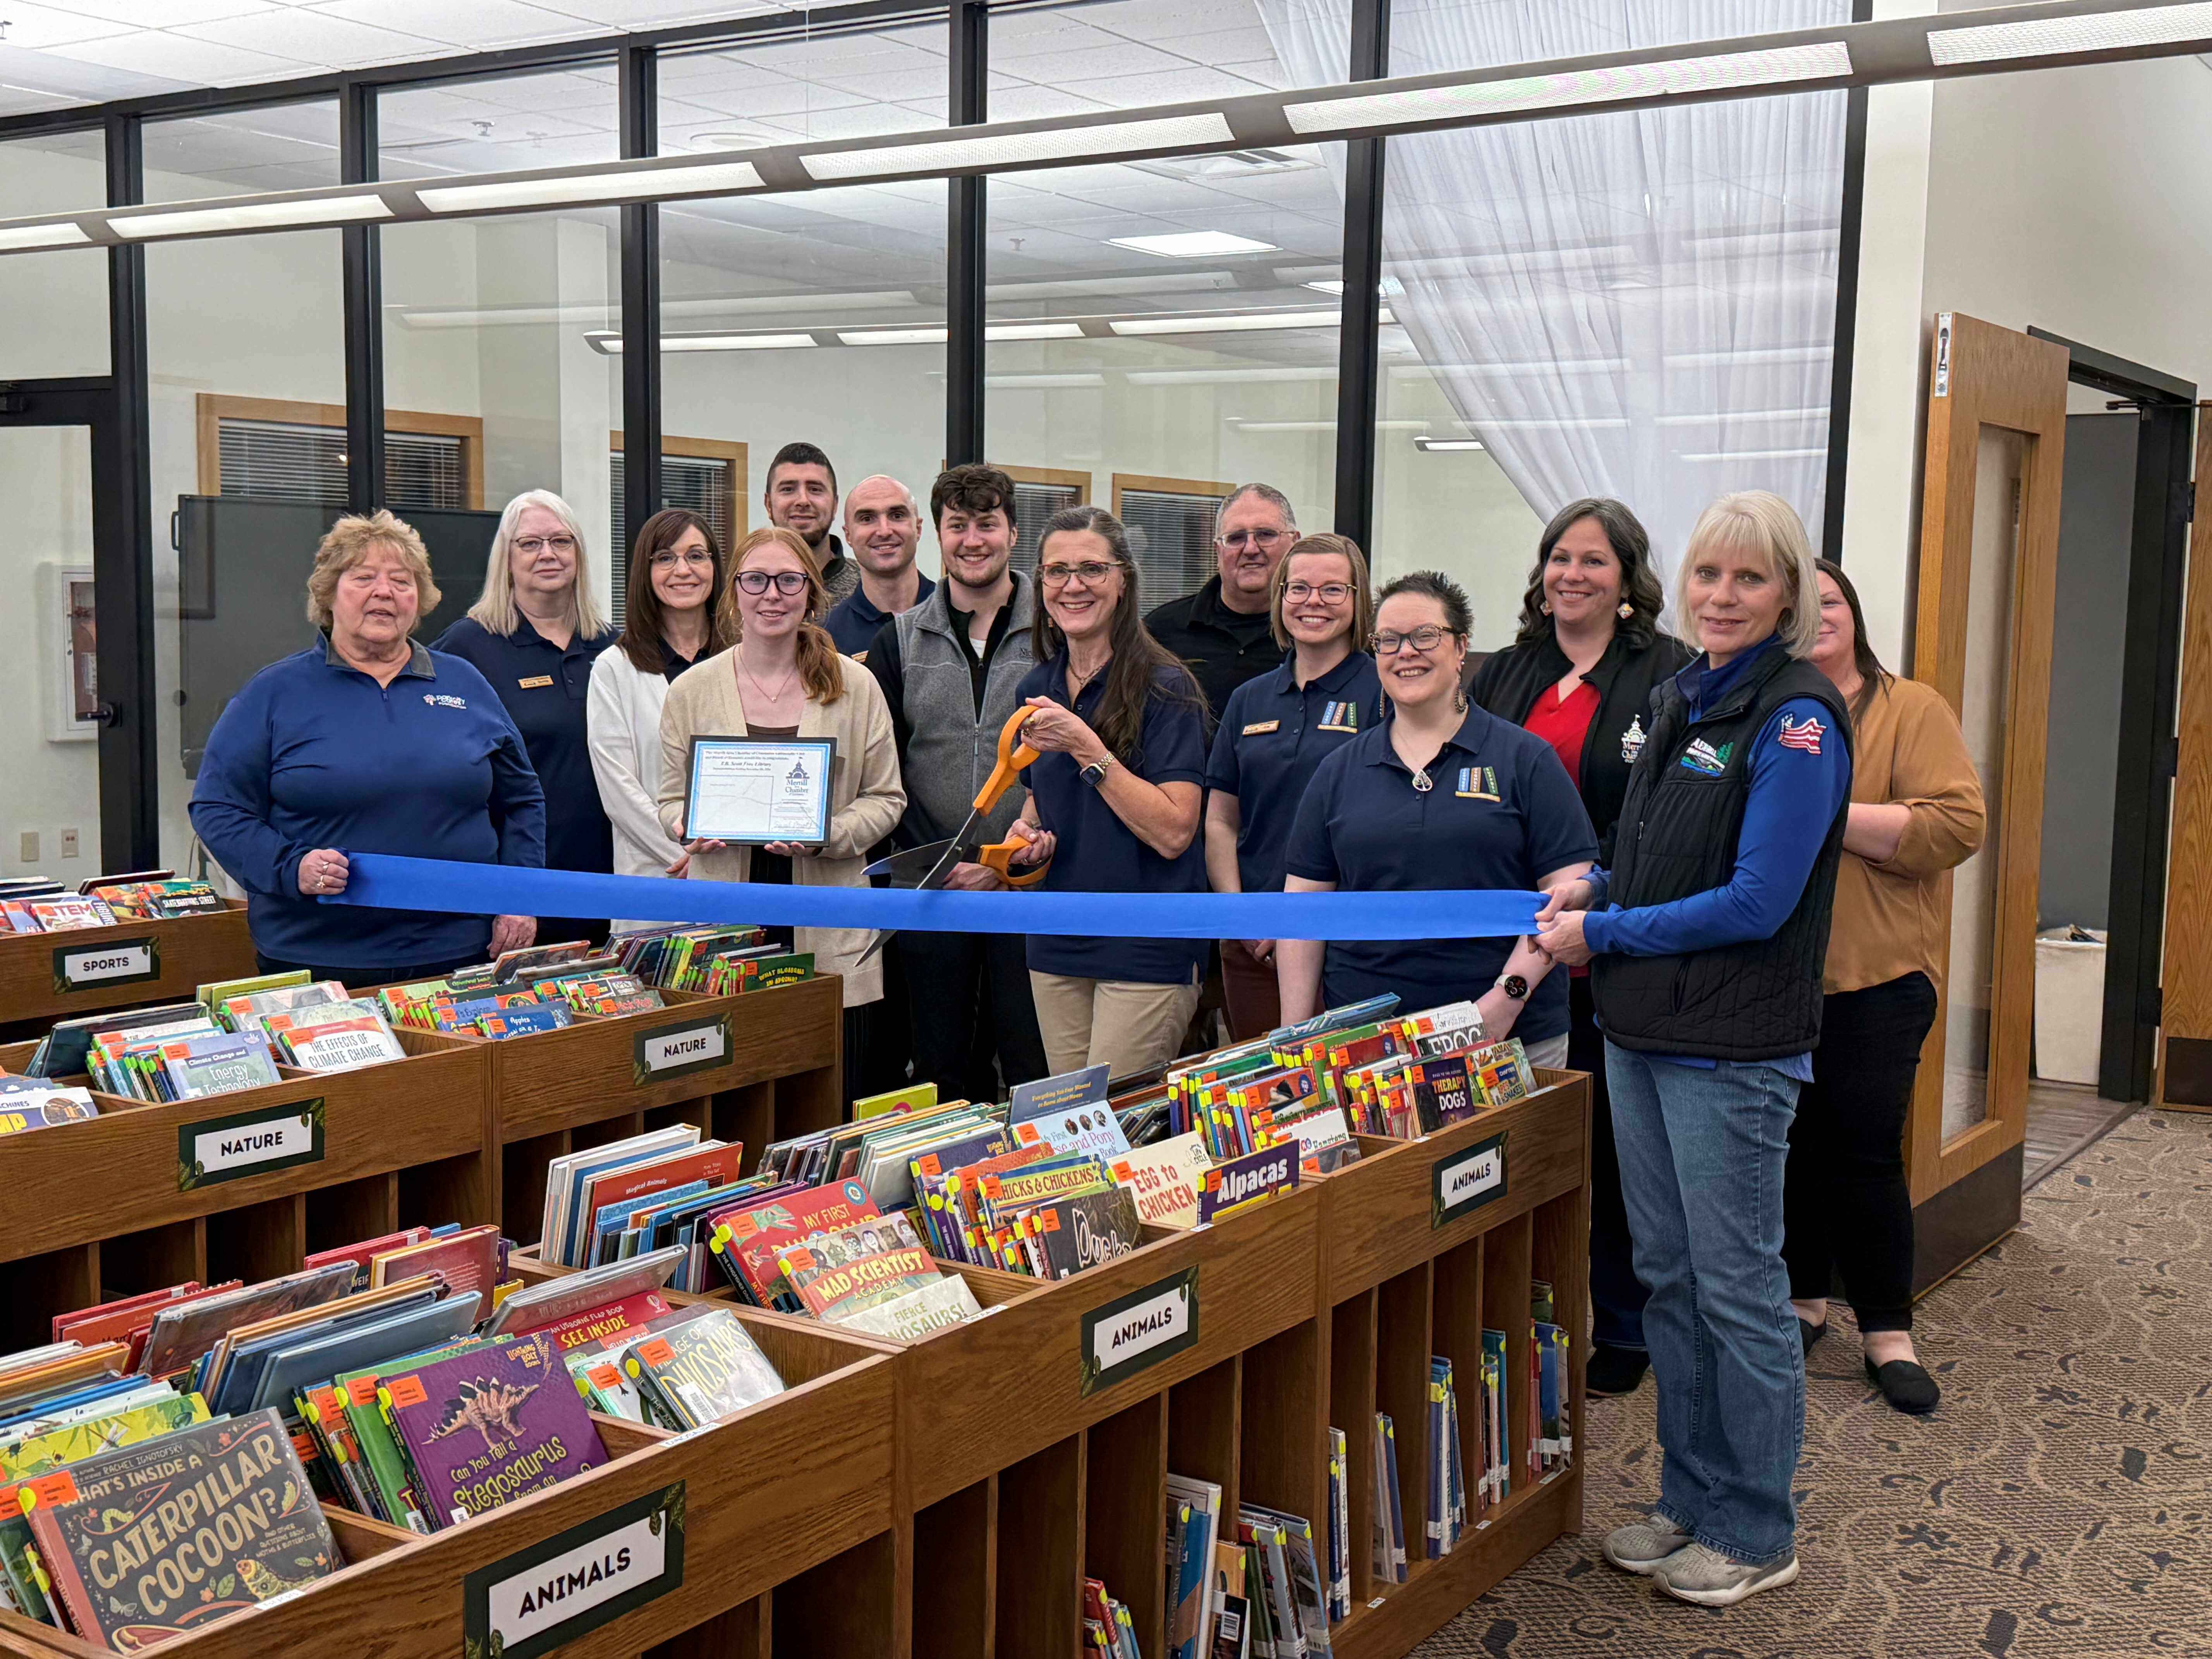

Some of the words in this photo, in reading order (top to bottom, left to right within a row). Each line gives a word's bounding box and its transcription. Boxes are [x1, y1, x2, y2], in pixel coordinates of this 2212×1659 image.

[83, 957, 129, 972] SPORTS
[759, 970, 776, 981] WHAT
[510, 1016, 531, 1025] Apples
[309, 1041, 326, 1053] THE
[327, 1036, 356, 1050] EFFECTS
[357, 1033, 368, 1045] OF
[664, 1037, 706, 1058] NATURE
[188, 1057, 211, 1066] Climate
[213, 1053, 234, 1063] Change
[235, 1049, 246, 1058] and
[308, 1051, 349, 1068] CLIMATE
[349, 1044, 385, 1061] CHANGE
[210, 1063, 248, 1085] Energy
[1432, 1076, 1466, 1094] THERAPY
[1438, 1091, 1467, 1111] DOGS
[221, 1132, 283, 1156] NATURE
[1052, 1130, 1068, 1142] First
[1069, 1134, 1091, 1150] and
[1091, 1130, 1116, 1145] Pony
[1098, 1144, 1119, 1158] Book
[625, 1182, 646, 1195] Magical
[646, 1178, 668, 1189] Animals
[1035, 1179, 1042, 1193] &
[1044, 1167, 1094, 1191] CHICKENS
[1132, 1166, 1161, 1194] EGG
[1161, 1164, 1178, 1183] to
[1216, 1158, 1288, 1204] Alpacas
[1452, 1162, 1491, 1194] ANIMALS
[1138, 1183, 1196, 1220] CHICKEN
[802, 1212, 821, 1230] MY
[821, 1203, 851, 1224] FIRST
[1073, 1208, 1133, 1271] Ducks
[720, 1254, 730, 1264] THE
[725, 1263, 745, 1290] KINGFISHER
[815, 1273, 852, 1302] MAD
[850, 1251, 925, 1286] SCIENTIST
[750, 1281, 761, 1293] MY
[854, 1276, 905, 1300] ACADEMY
[560, 1316, 589, 1331] USBORNE
[589, 1312, 606, 1322] FLAP
[606, 1305, 625, 1317] BOOK
[893, 1301, 928, 1323] FIERCE
[561, 1328, 589, 1348] SEE
[587, 1314, 630, 1338] INSIDE
[1111, 1306, 1173, 1349] ANIMALS
[506, 1343, 536, 1361] LIGHTNING
[671, 1335, 692, 1357] AGE
[689, 1324, 705, 1341] OF
[521, 1351, 538, 1363] BOLT
[524, 1360, 541, 1369] BOOKS
[649, 1395, 663, 1412] THE
[103, 1459, 135, 1474] RACHEL
[135, 1443, 184, 1465] IGNOTOFSKY
[451, 1465, 471, 1483] Can
[468, 1455, 490, 1473] You
[488, 1441, 508, 1462] Tell
[508, 1440, 518, 1451] a
[126, 1458, 186, 1488] INSIDE
[188, 1455, 203, 1469] A
[453, 1436, 568, 1517] Stegosaurus
[89, 1433, 283, 1589] CATERPILLAR
[289, 1527, 306, 1537] ABOUT
[137, 1487, 276, 1616] COCOON?
[256, 1547, 276, 1558] MOTHS
[282, 1532, 316, 1549] BUTTERFLIES
[518, 1547, 631, 1620] ANIMALS
